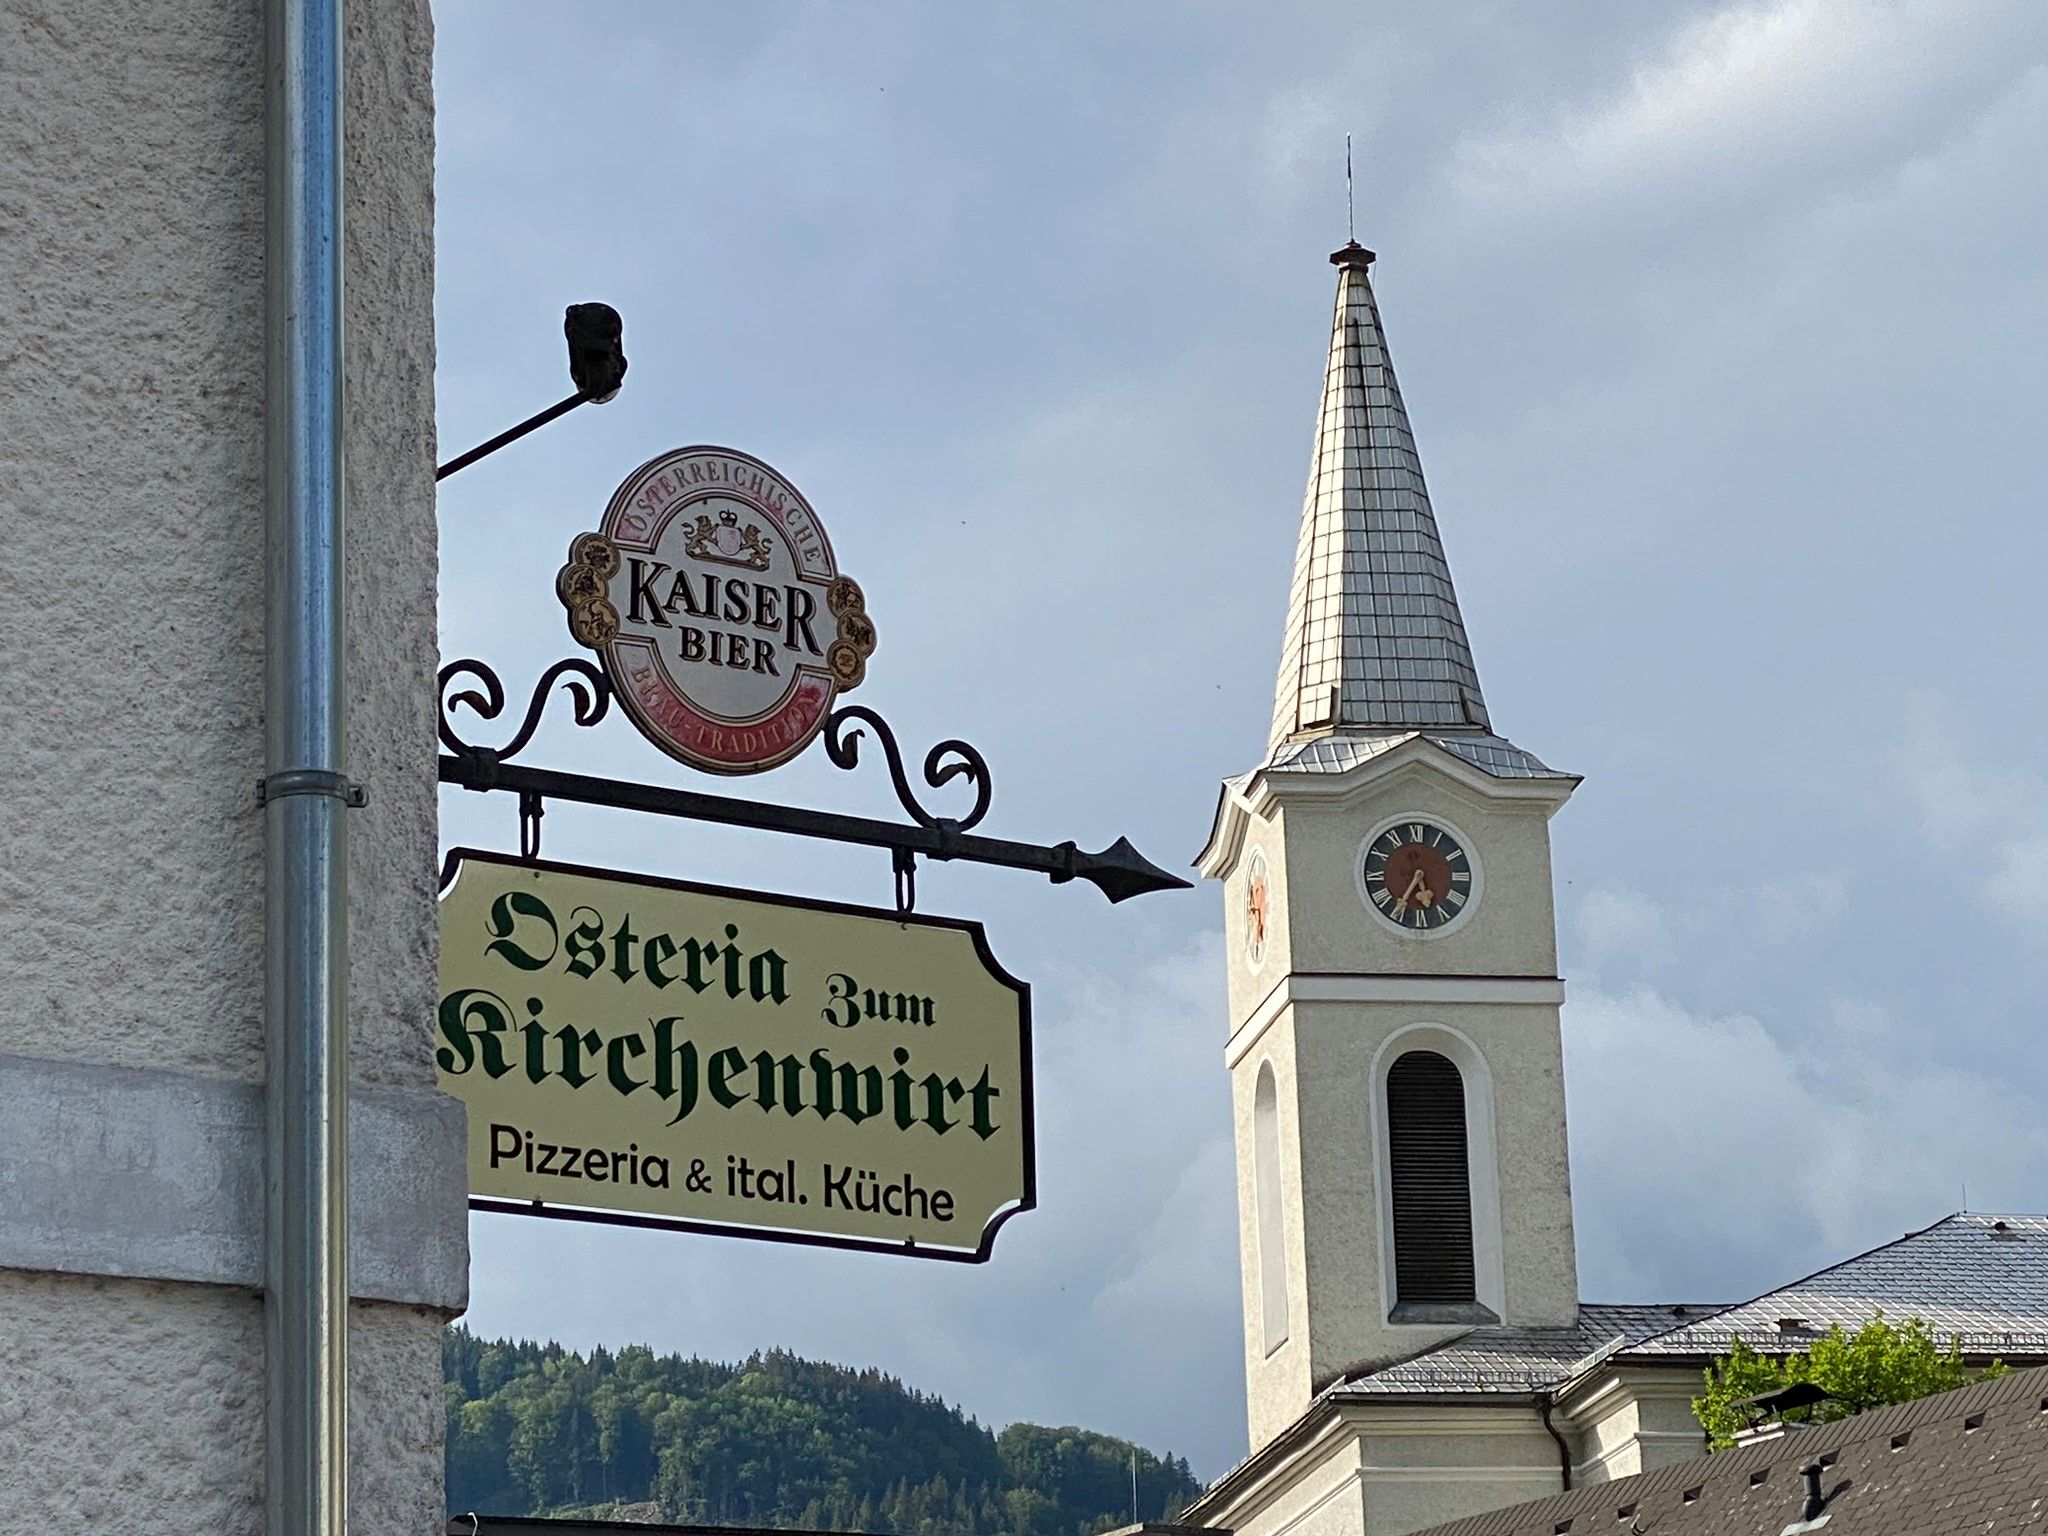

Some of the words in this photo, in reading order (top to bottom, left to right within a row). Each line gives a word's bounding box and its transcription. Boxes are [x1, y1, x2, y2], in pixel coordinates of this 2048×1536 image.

[623, 461, 821, 562] ÖSTERREICHISCHE
[626, 557, 823, 656] KAISER
[679, 626, 780, 677] BIER
[484, 892, 791, 1005] Osteria
[821, 973, 937, 1029] Zum
[436, 988, 1001, 1142] Kirchenwirt
[489, 1122, 670, 1190] Pizzeria
[685, 1157, 713, 1194] &
[726, 1153, 809, 1206] ital.
[823, 1164, 956, 1223] Küche
